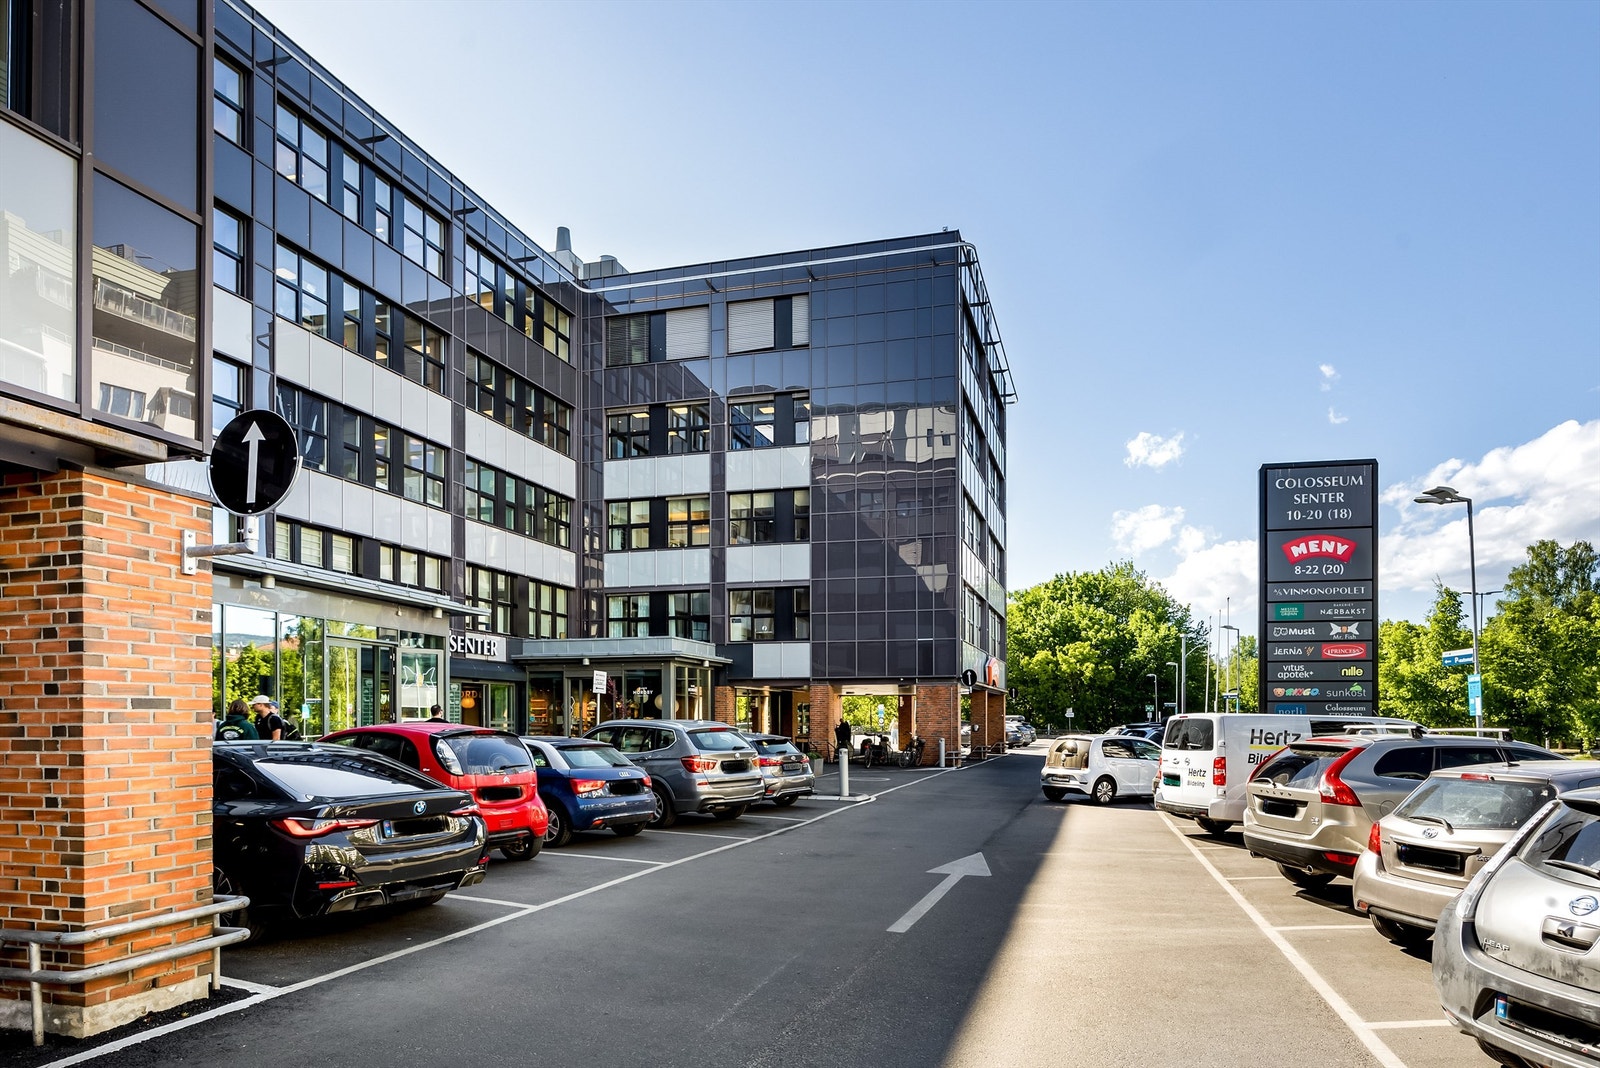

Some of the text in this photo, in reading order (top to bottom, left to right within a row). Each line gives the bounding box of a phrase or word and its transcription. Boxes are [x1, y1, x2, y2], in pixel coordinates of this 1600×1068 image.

[1276, 476, 1363, 489] COLOSSEUM
[1294, 492, 1344, 504] SENTER
[1286, 508, 1352, 520] 10-20 (18)
[1290, 540, 1349, 558] MENY
[1294, 564, 1344, 575] 8-22 (20)
[1282, 586, 1366, 596] VINMONOPOLET
[450, 635, 498, 656] SENTER
[1342, 666, 1363, 676] nille
[1326, 688, 1366, 697] sunkost
[1250, 729, 1301, 745] Hertz
[1188, 768, 1206, 777] Hertz
